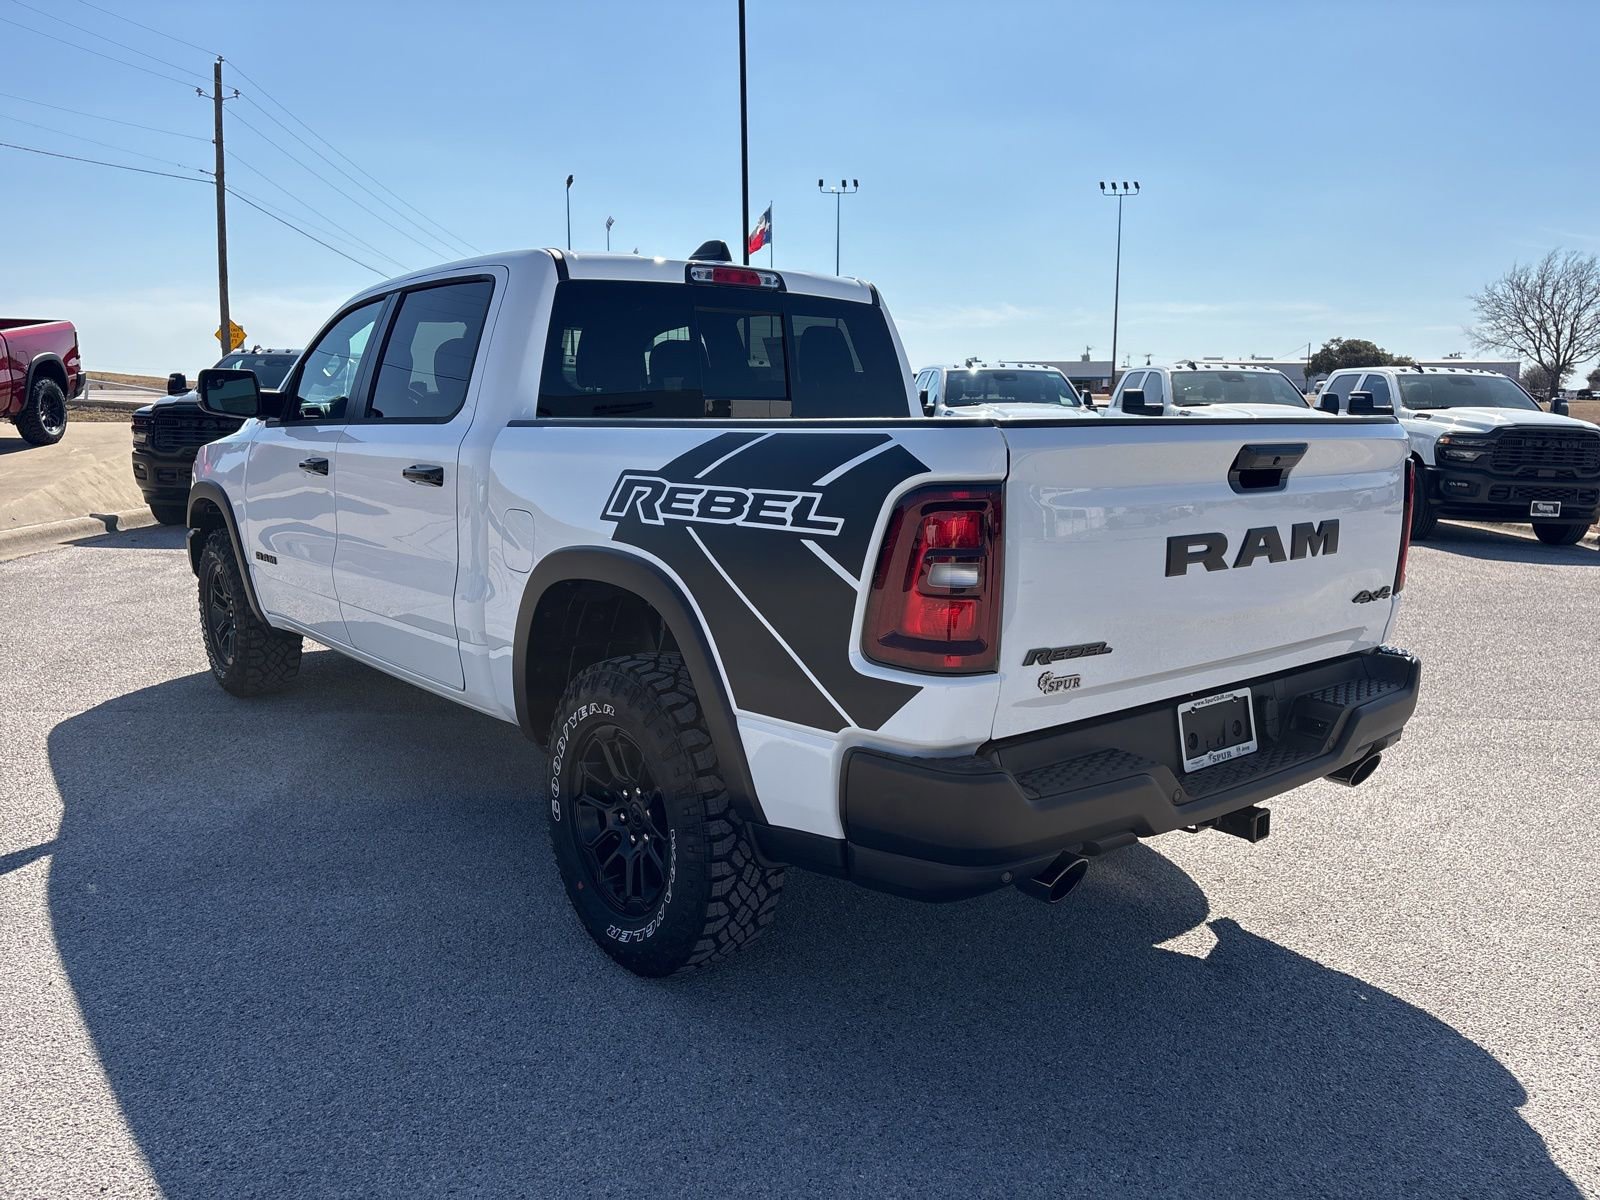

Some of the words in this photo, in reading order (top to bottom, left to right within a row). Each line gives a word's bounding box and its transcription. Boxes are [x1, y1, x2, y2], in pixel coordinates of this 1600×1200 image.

[605, 474, 846, 537] REBEL
[255, 551, 278, 565] RAM
[1164, 518, 1340, 578] RAM
[1021, 640, 1114, 667] REBEL
[1047, 677, 1081, 693] SPUR
[551, 702, 616, 822] GOODYEAR
[1212, 750, 1232, 763] SPUR
